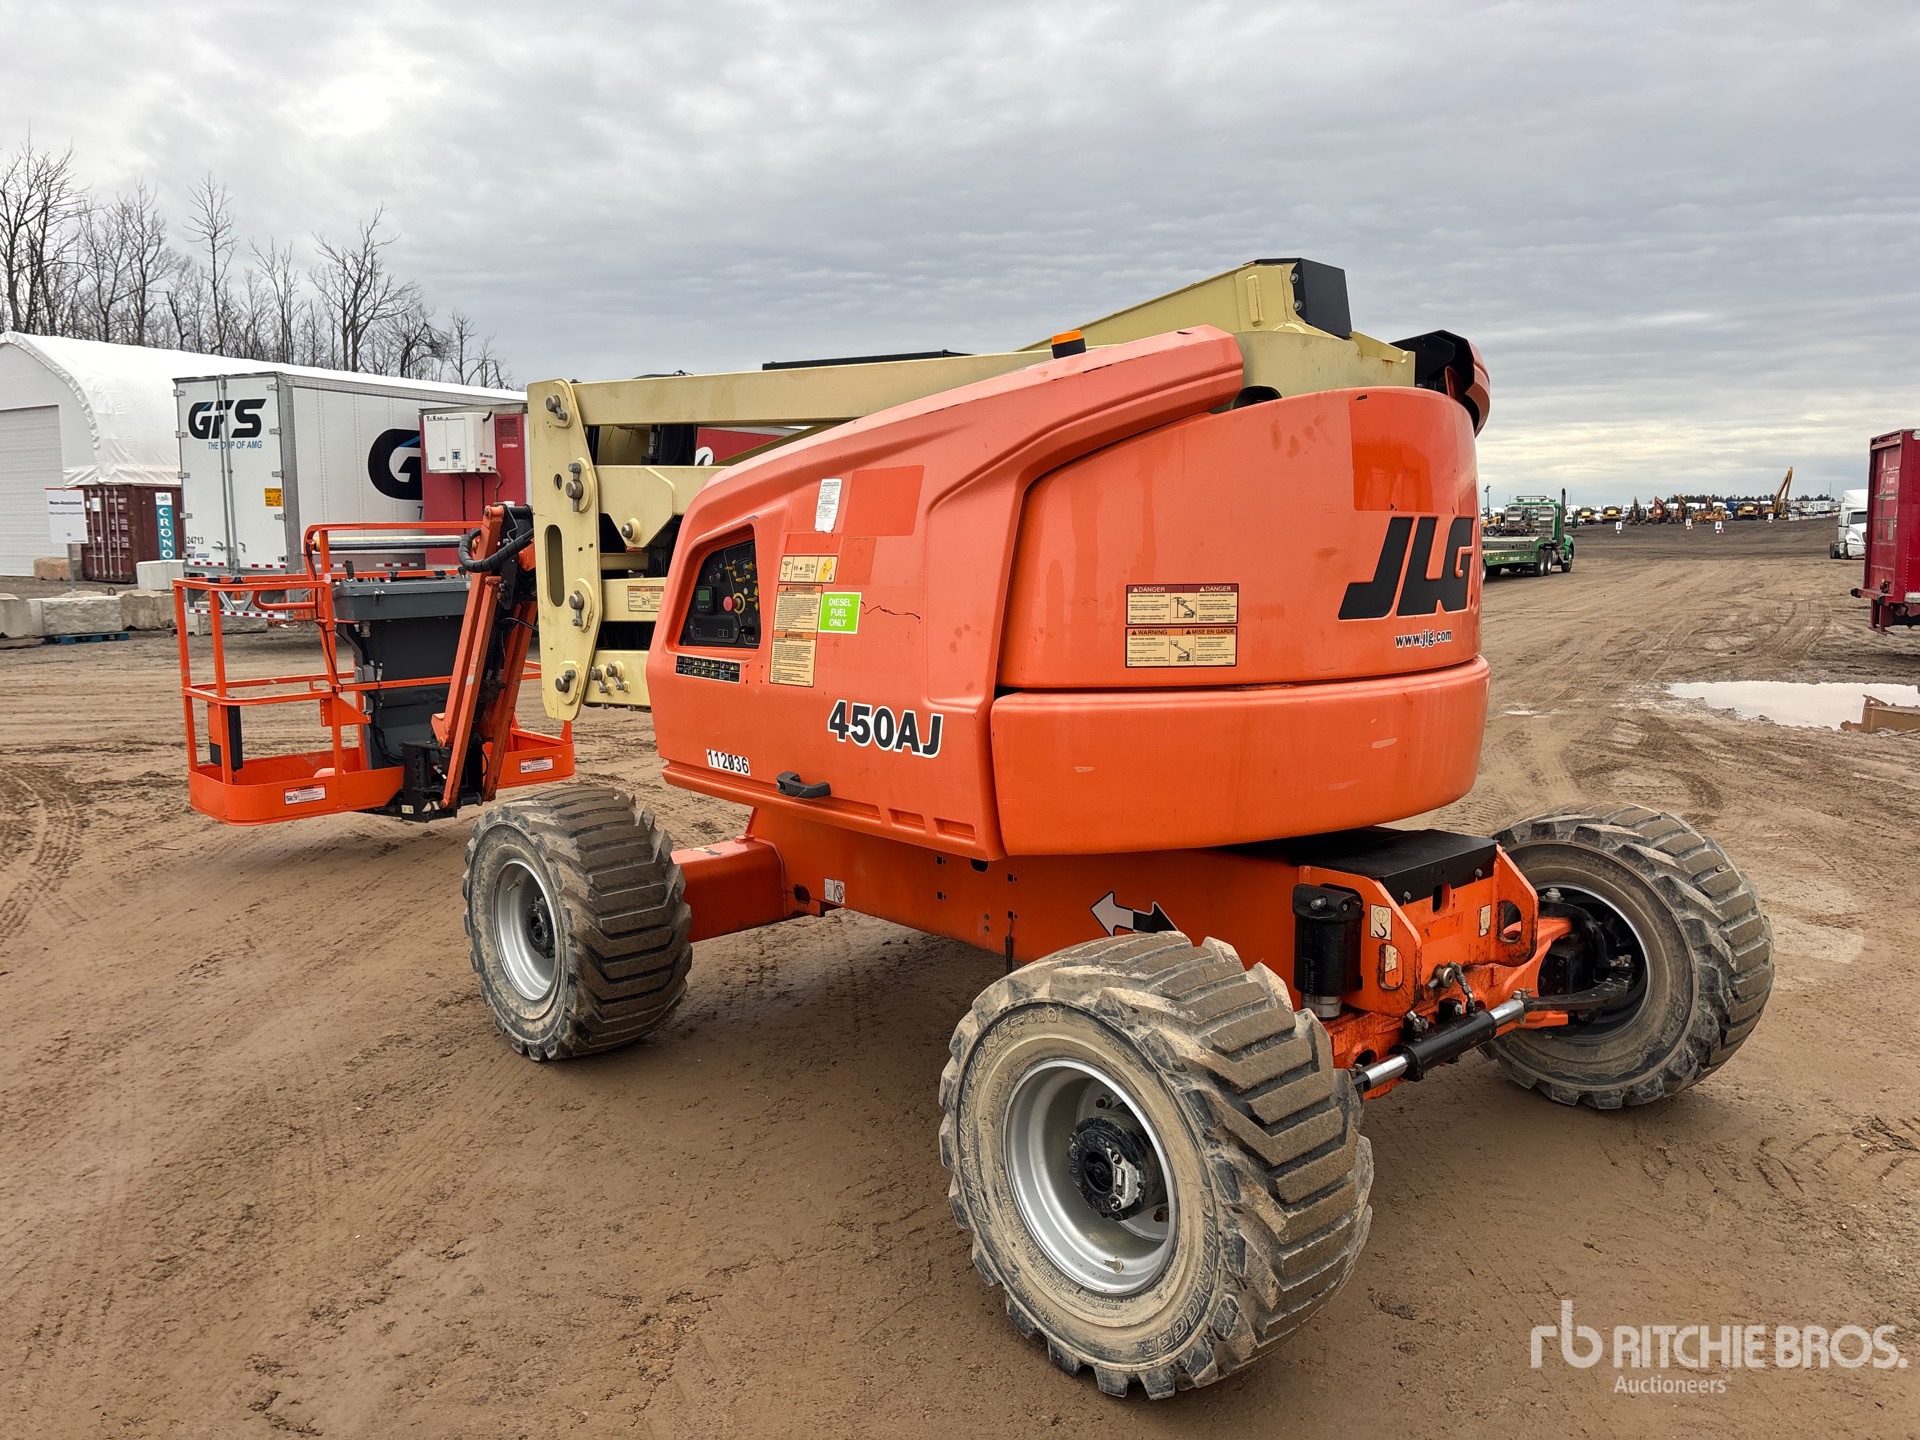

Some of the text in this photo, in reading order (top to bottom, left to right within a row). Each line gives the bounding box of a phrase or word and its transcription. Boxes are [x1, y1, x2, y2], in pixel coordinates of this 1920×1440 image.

[188, 398, 267, 439] GFS
[208, 441, 219, 450] THE
[236, 440, 246, 449] OF
[247, 440, 263, 449] AMG
[1338, 516, 1474, 620] JLG
[828, 597, 852, 607] DIESEL
[830, 608, 848, 617] FUEL
[829, 618, 848, 627] ONLY
[1395, 629, 1452, 647] www.jlg.com
[828, 699, 943, 758] 450AJ
[708, 749, 749, 774] 112036
